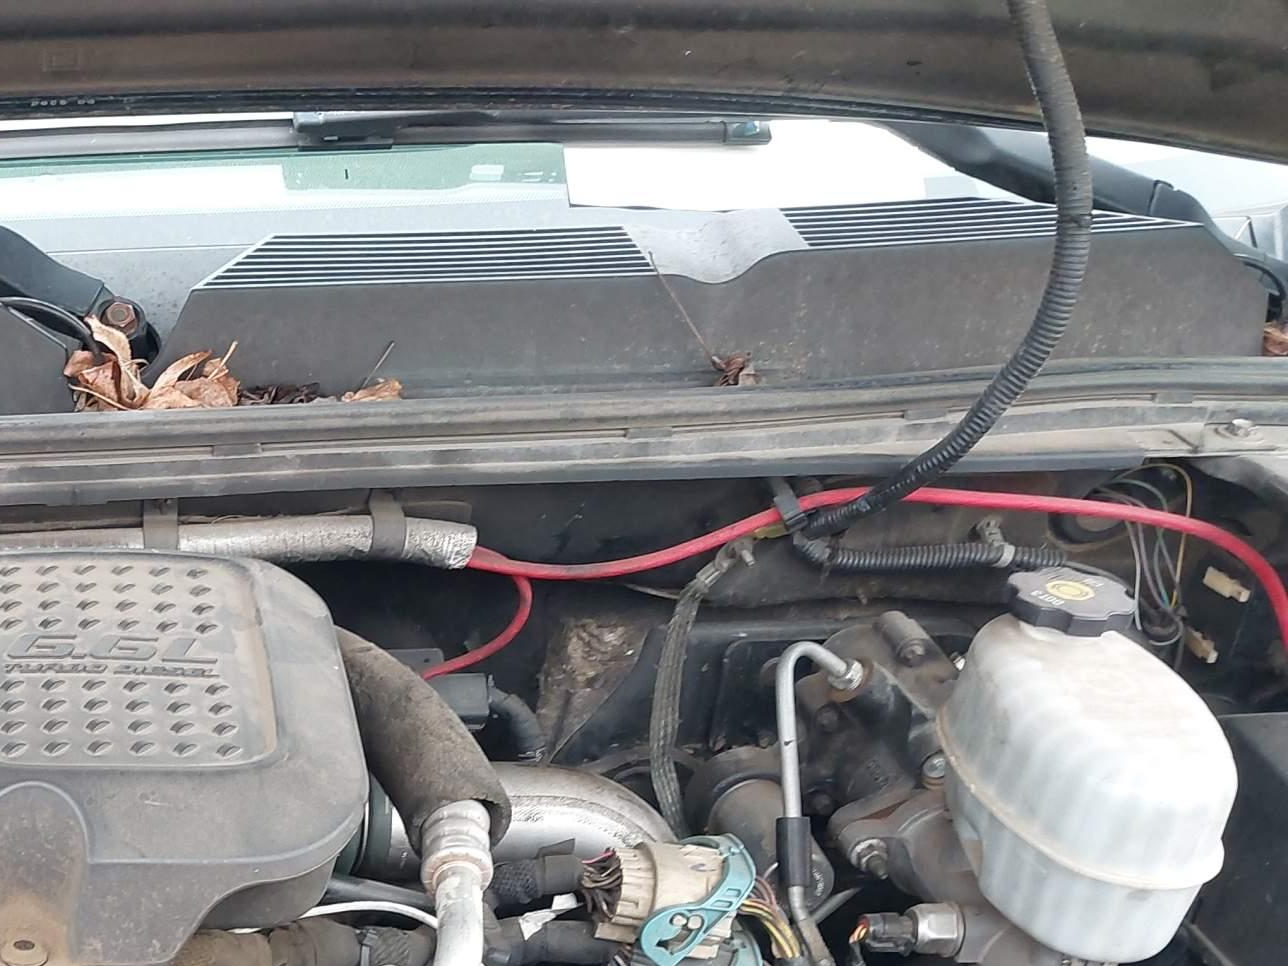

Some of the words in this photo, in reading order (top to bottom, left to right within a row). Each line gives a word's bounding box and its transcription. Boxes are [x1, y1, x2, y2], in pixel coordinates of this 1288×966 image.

[5, 634, 219, 664] 6.6L
[4, 663, 108, 675] TURBO
[113, 665, 220, 679] DIESEL
